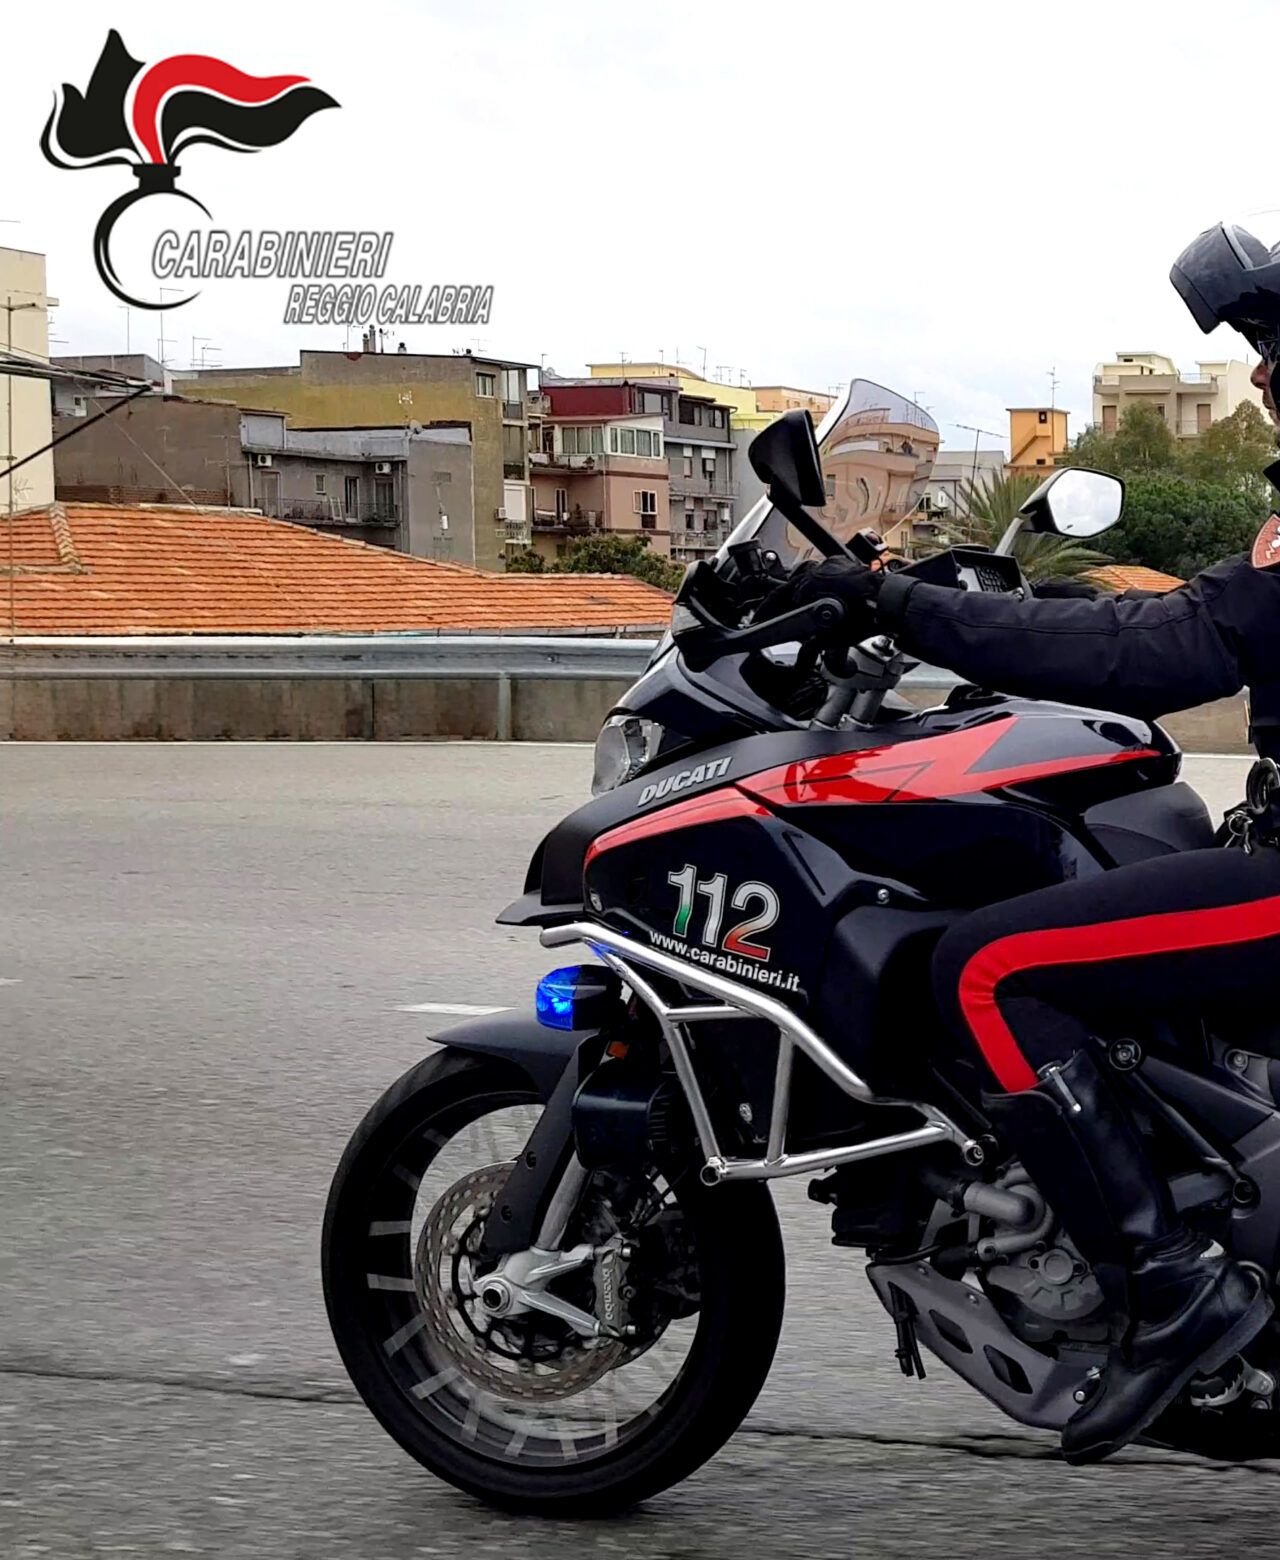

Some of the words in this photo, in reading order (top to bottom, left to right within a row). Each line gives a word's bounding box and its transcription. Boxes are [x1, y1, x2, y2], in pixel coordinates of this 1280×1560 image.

[637, 756, 733, 808] DUCATI
[667, 863, 781, 962] 112
[649, 929, 801, 993] www.carabinieri.it
[602, 1267, 615, 1321] brembo
